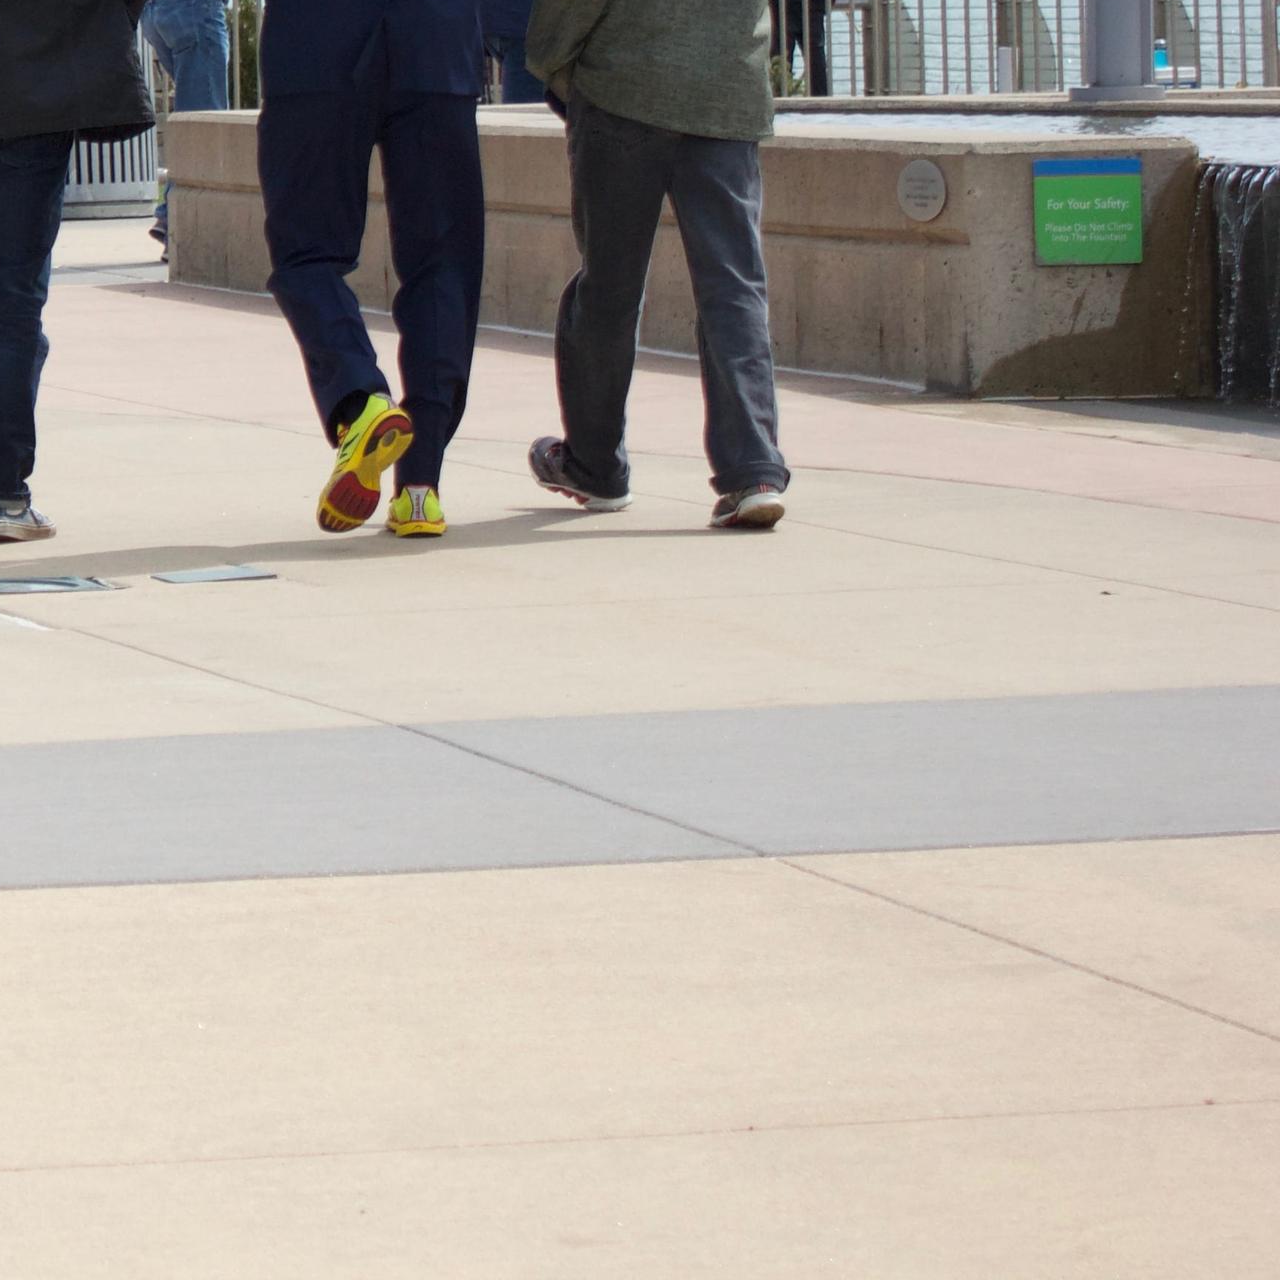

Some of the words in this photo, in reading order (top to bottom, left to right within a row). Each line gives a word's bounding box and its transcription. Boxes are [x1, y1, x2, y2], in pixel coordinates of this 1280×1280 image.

[1047, 199, 1064, 210] For
[1067, 199, 1090, 210] Your
[1094, 197, 1129, 212] Safety:
[1045, 223, 1072, 232] Please
[1074, 223, 1087, 232] Do
[1089, 223, 1105, 232] Not
[1107, 223, 1133, 232] Climb
[1052, 233, 1069, 242] Into
[1072, 233, 1087, 241] The
[1089, 233, 1127, 241] Fountain
